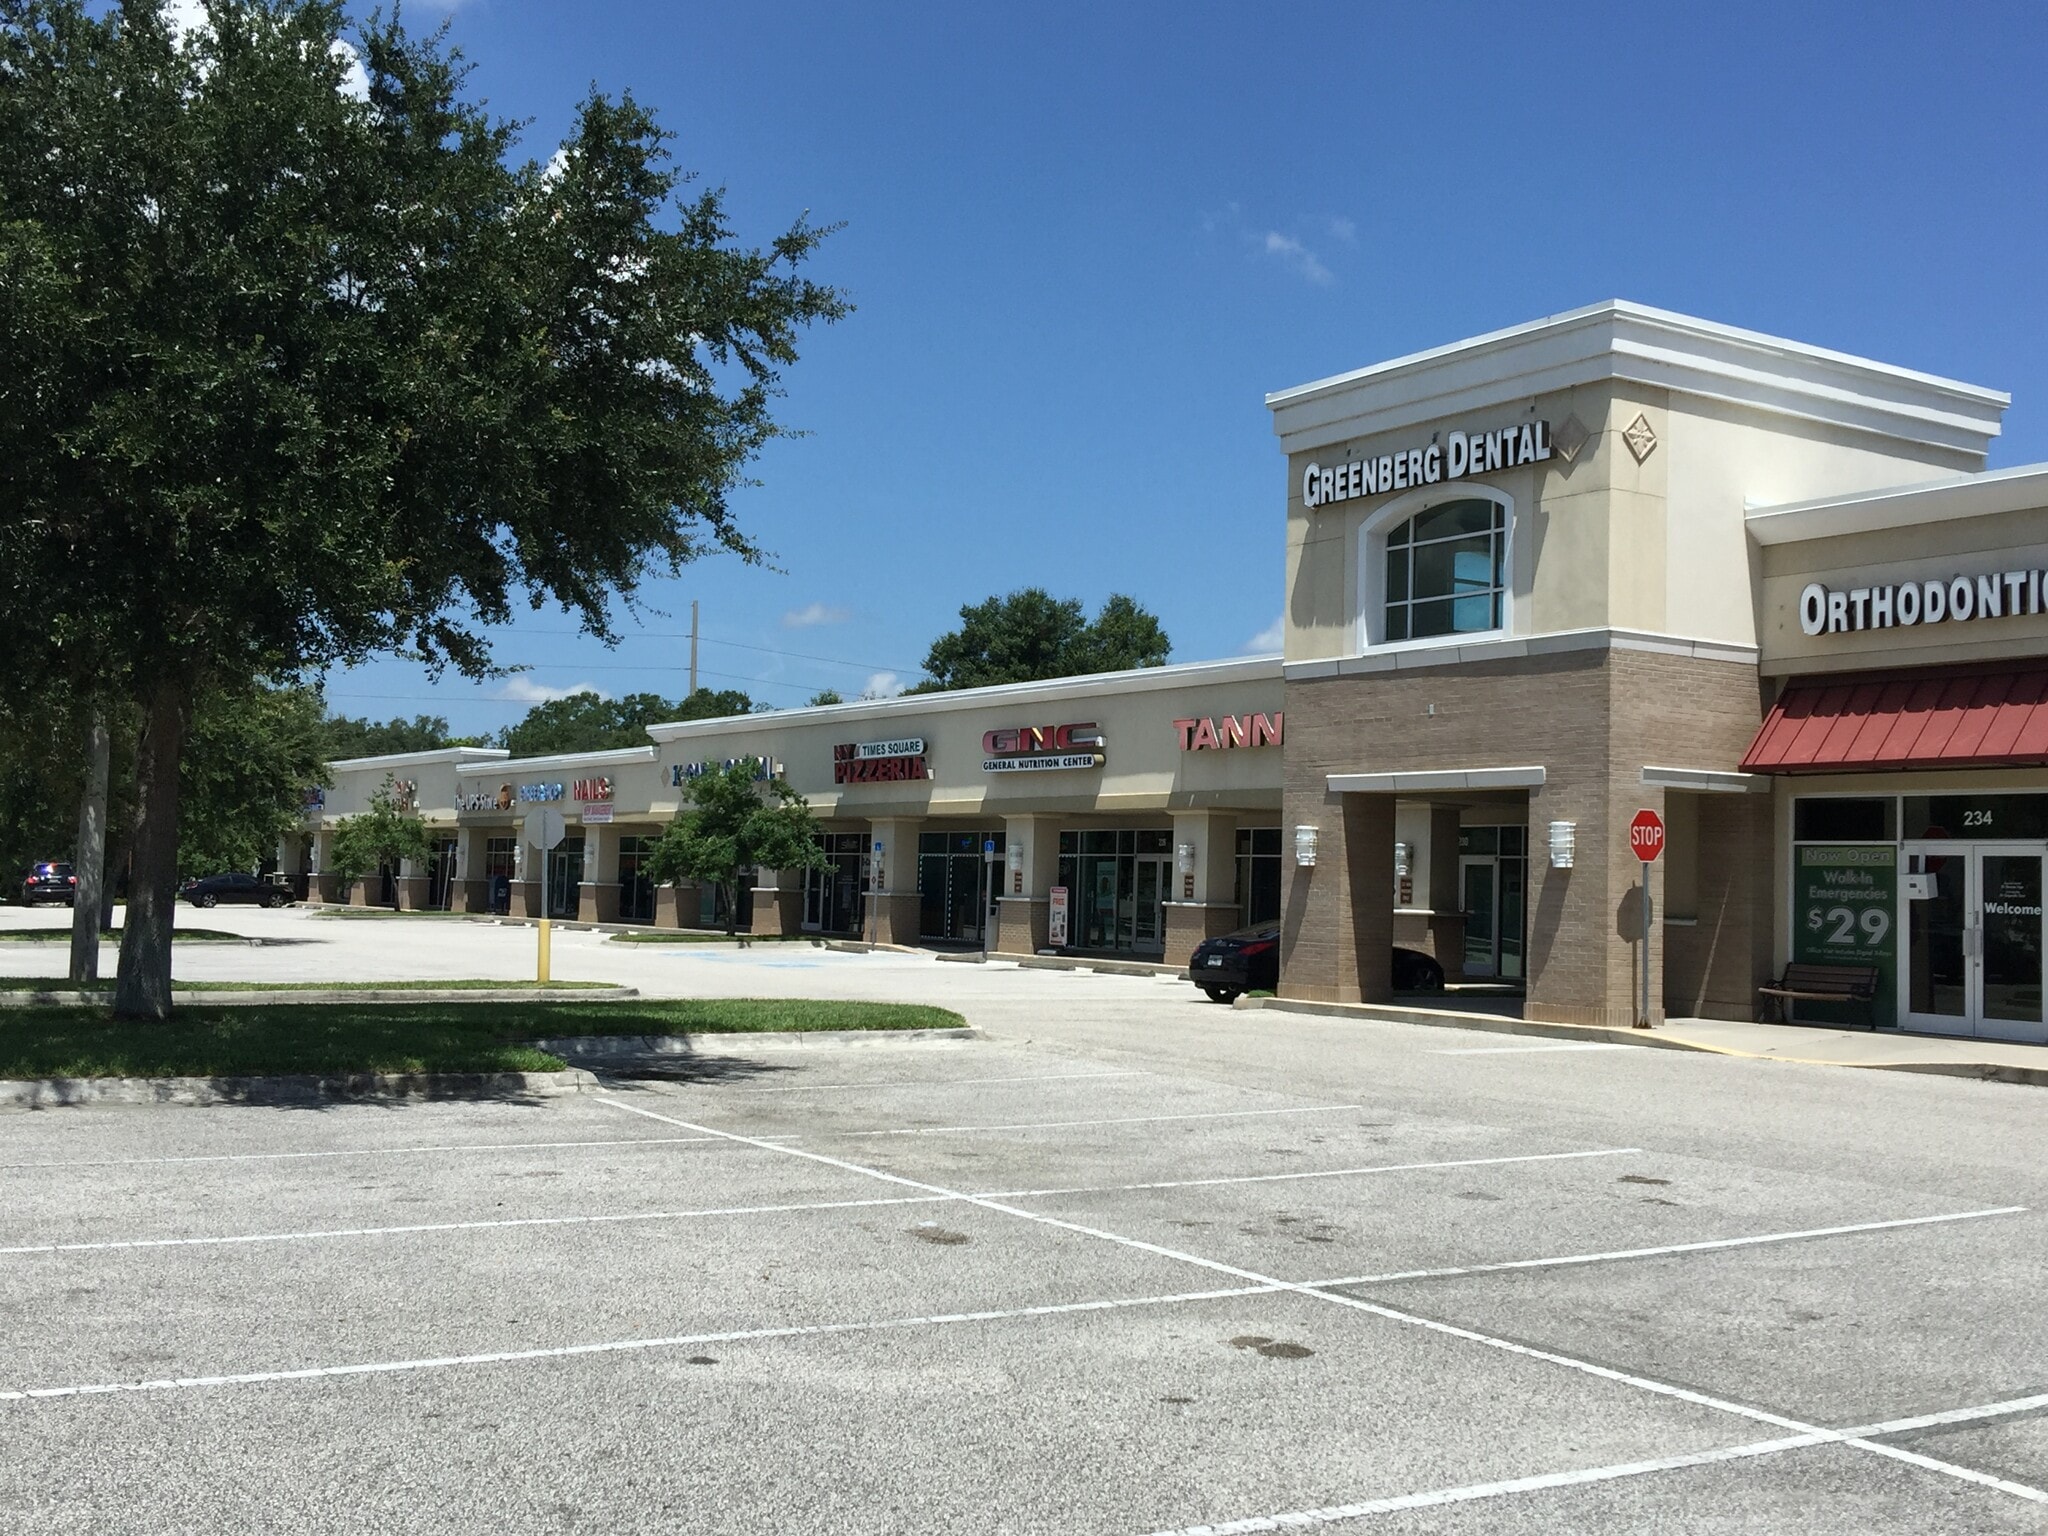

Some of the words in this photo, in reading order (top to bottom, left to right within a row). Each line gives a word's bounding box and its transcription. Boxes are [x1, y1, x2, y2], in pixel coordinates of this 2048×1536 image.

[1303, 444, 1441, 508] GREENBERG
[1448, 420, 1551, 479] DENTAL
[1800, 569, 2048, 636] ORTHODONTI
[982, 722, 1098, 754] GNC
[1172, 711, 1284, 751] TANN
[834, 744, 857, 760] NY
[862, 744, 886, 756] TIMES
[888, 741, 921, 754] SQUARE
[834, 757, 928, 784] PIZZERIA
[983, 761, 1016, 771] GENERAL
[1018, 758, 1060, 769] NUTRITION
[1063, 756, 1093, 766] CENTER
[573, 777, 609, 800] NAILS
[1964, 810, 1993, 825] 234
[1632, 825, 1662, 846] STOP
[1806, 849, 1840, 861] Now
[1847, 849, 1890, 864] Open
[1823, 870, 1874, 884] Walk-In
[1809, 886, 1888, 902] Emergencies
[1984, 902, 2042, 915] Welcome
[1807, 905, 1890, 945] $29
